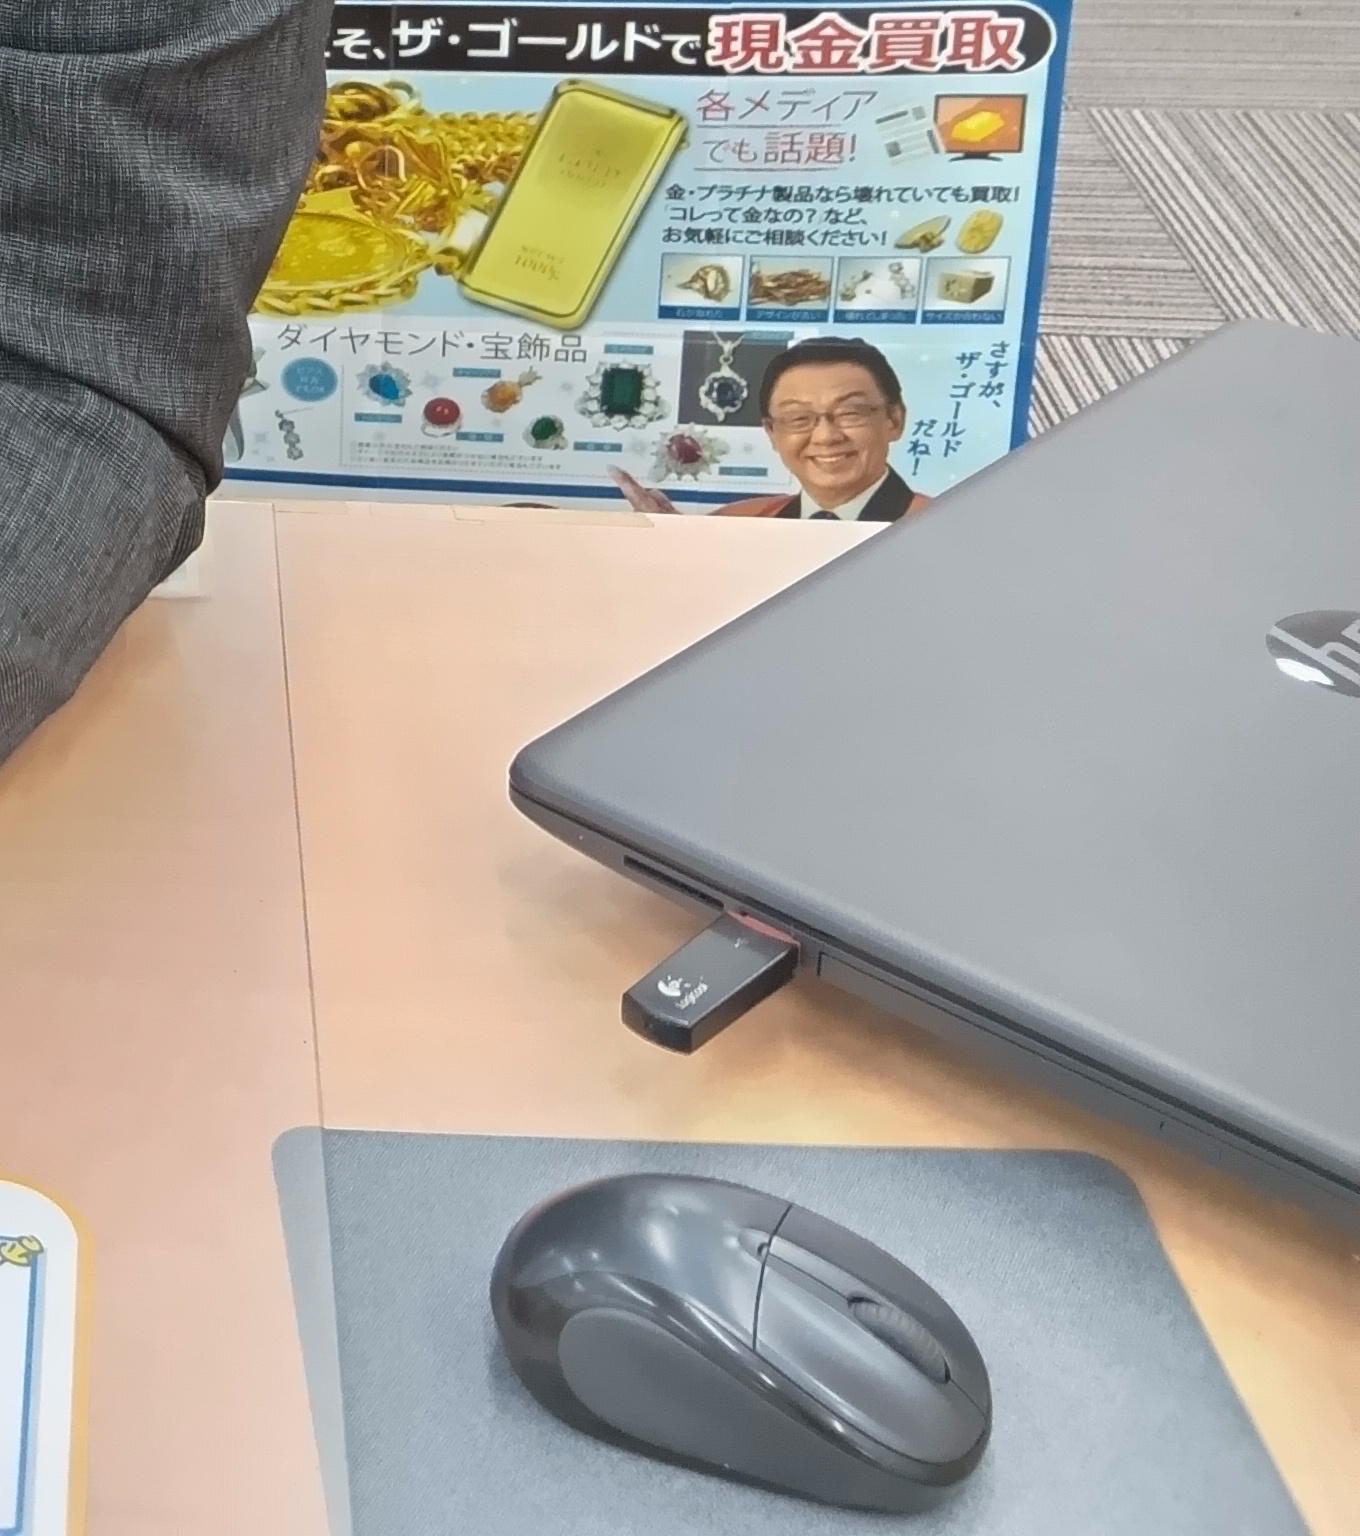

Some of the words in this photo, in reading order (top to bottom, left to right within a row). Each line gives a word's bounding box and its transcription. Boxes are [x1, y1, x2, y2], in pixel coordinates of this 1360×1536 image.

[695, 88, 880, 127] 各メディア
[276, 322, 588, 364] ダイヤモンド・宝飾品
